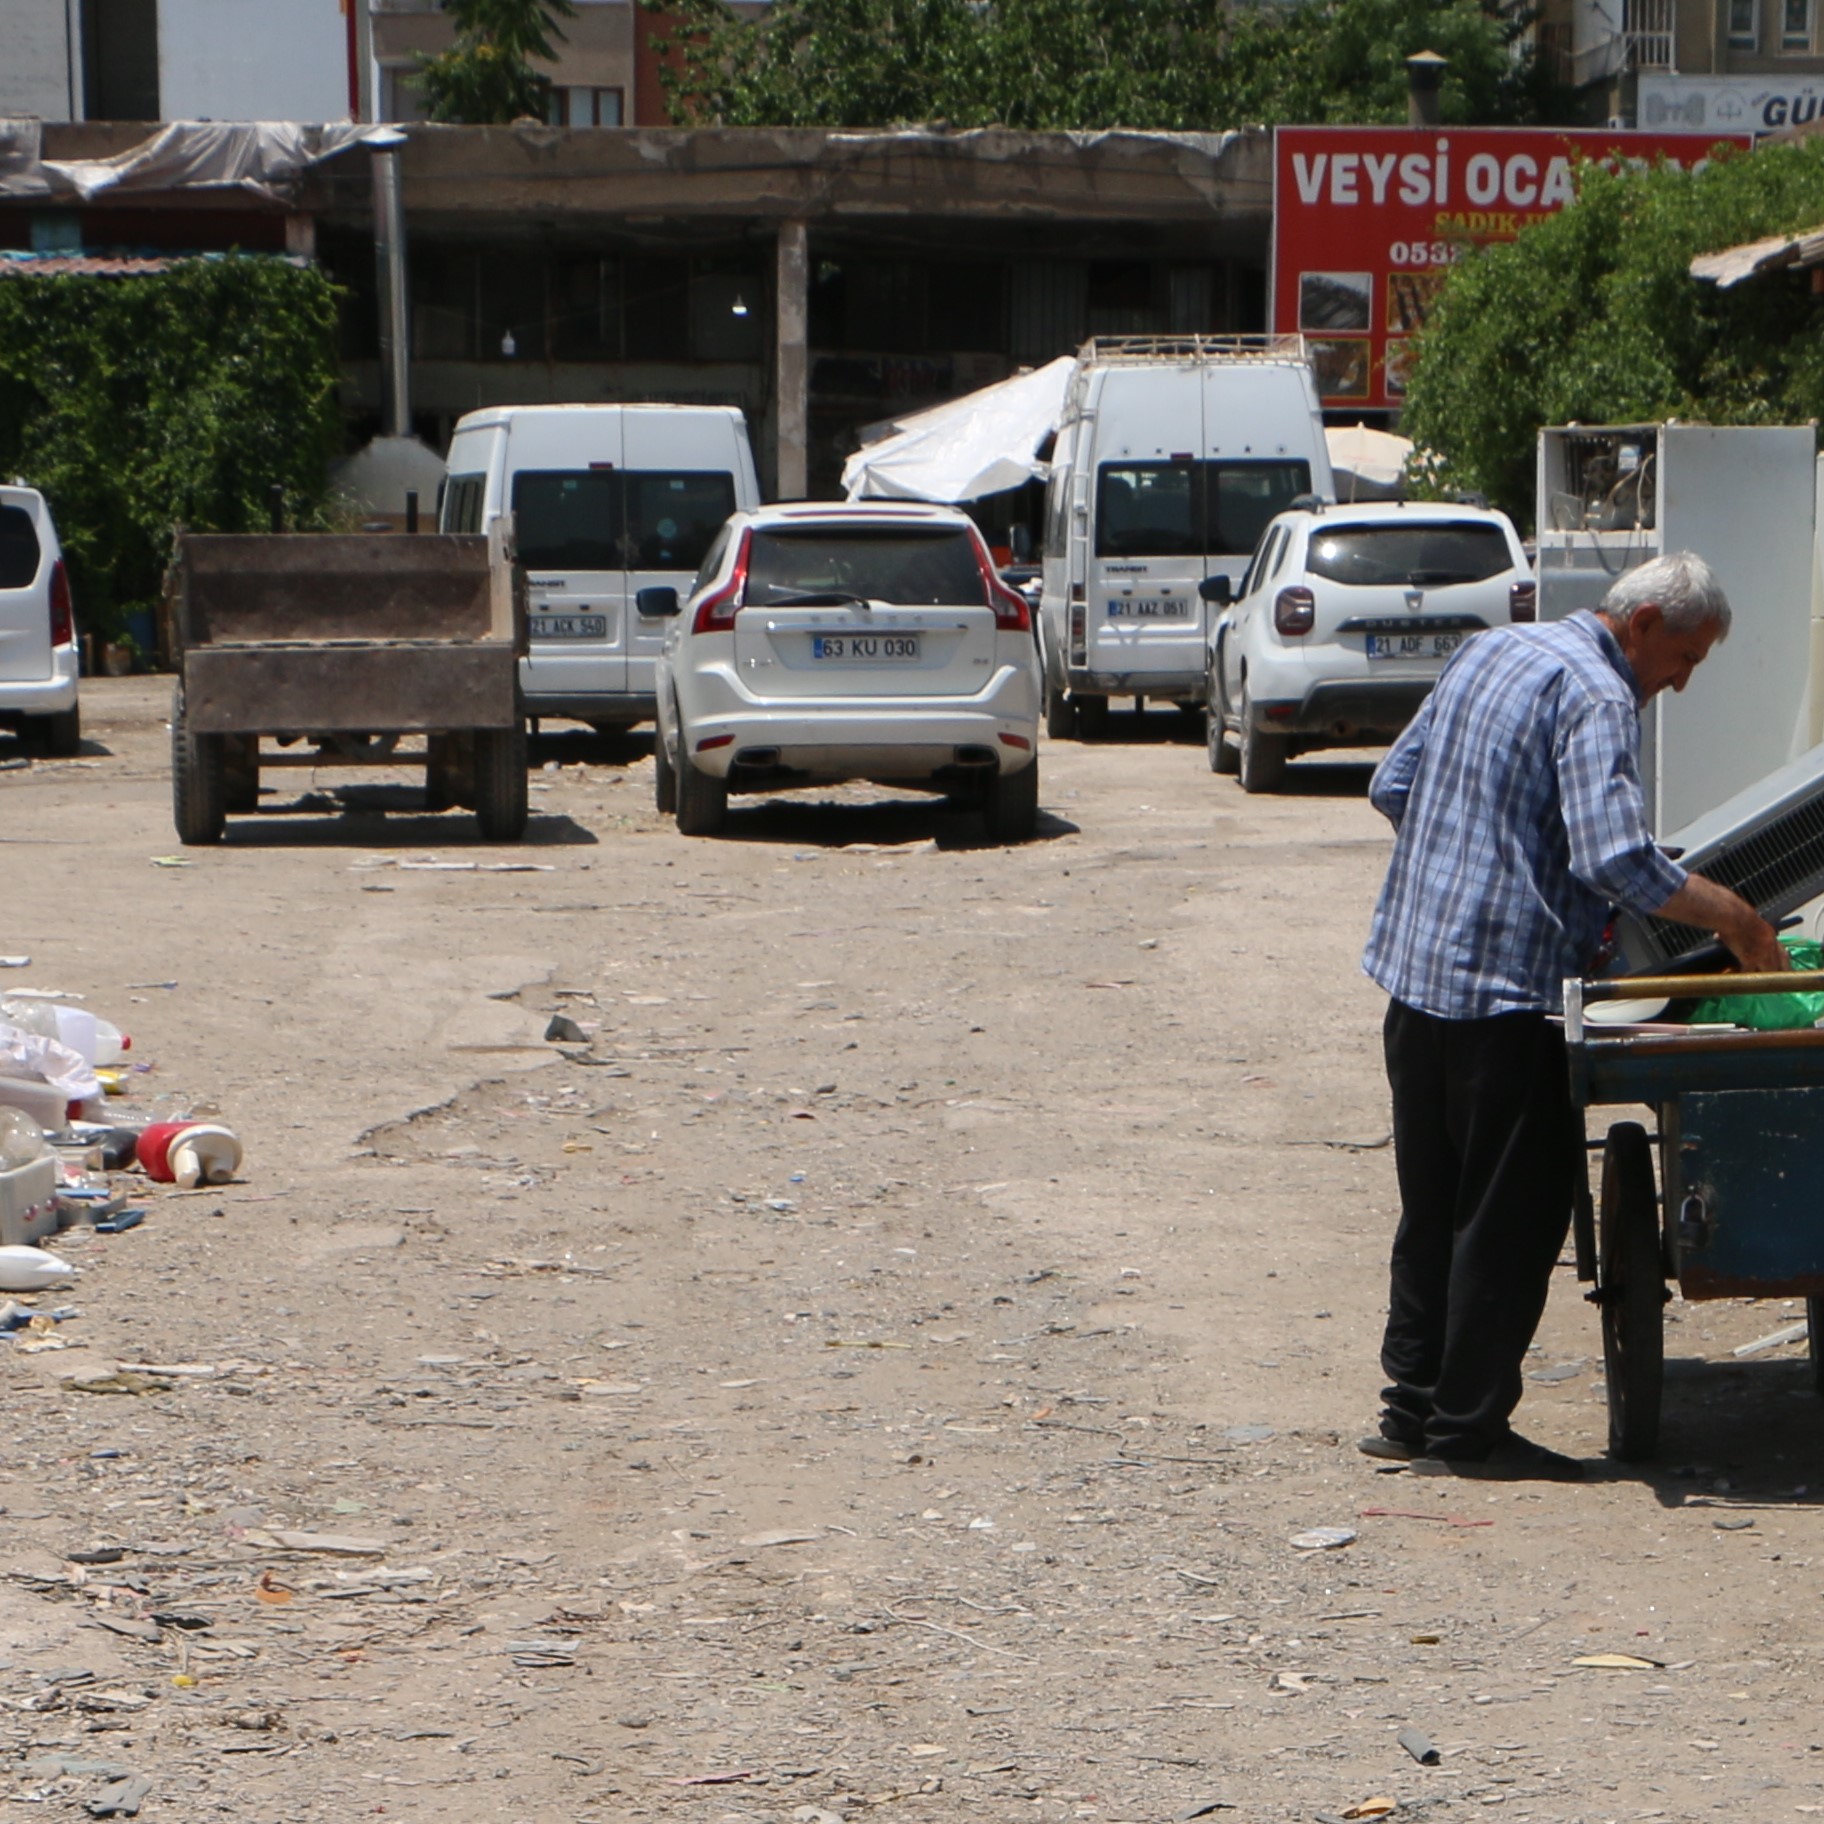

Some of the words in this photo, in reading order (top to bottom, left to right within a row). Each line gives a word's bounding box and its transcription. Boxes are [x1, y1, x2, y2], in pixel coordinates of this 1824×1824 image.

[1291, 137, 1449, 206] VEYSİ
[528, 579, 566, 587] RANSIT
[1118, 601, 1131, 615] 21
[1138, 601, 1158, 615] AAZ
[1163, 601, 1184, 615] 051
[531, 618, 545, 633] 21
[553, 618, 574, 633] ACK
[580, 617, 602, 632] 540
[822, 639, 844, 656] 63
[852, 639, 876, 656] KU
[884, 639, 915, 656] 030
[1376, 637, 1391, 653] 21
[1400, 636, 1424, 651] ADF
[1433, 635, 1460, 651] 663
